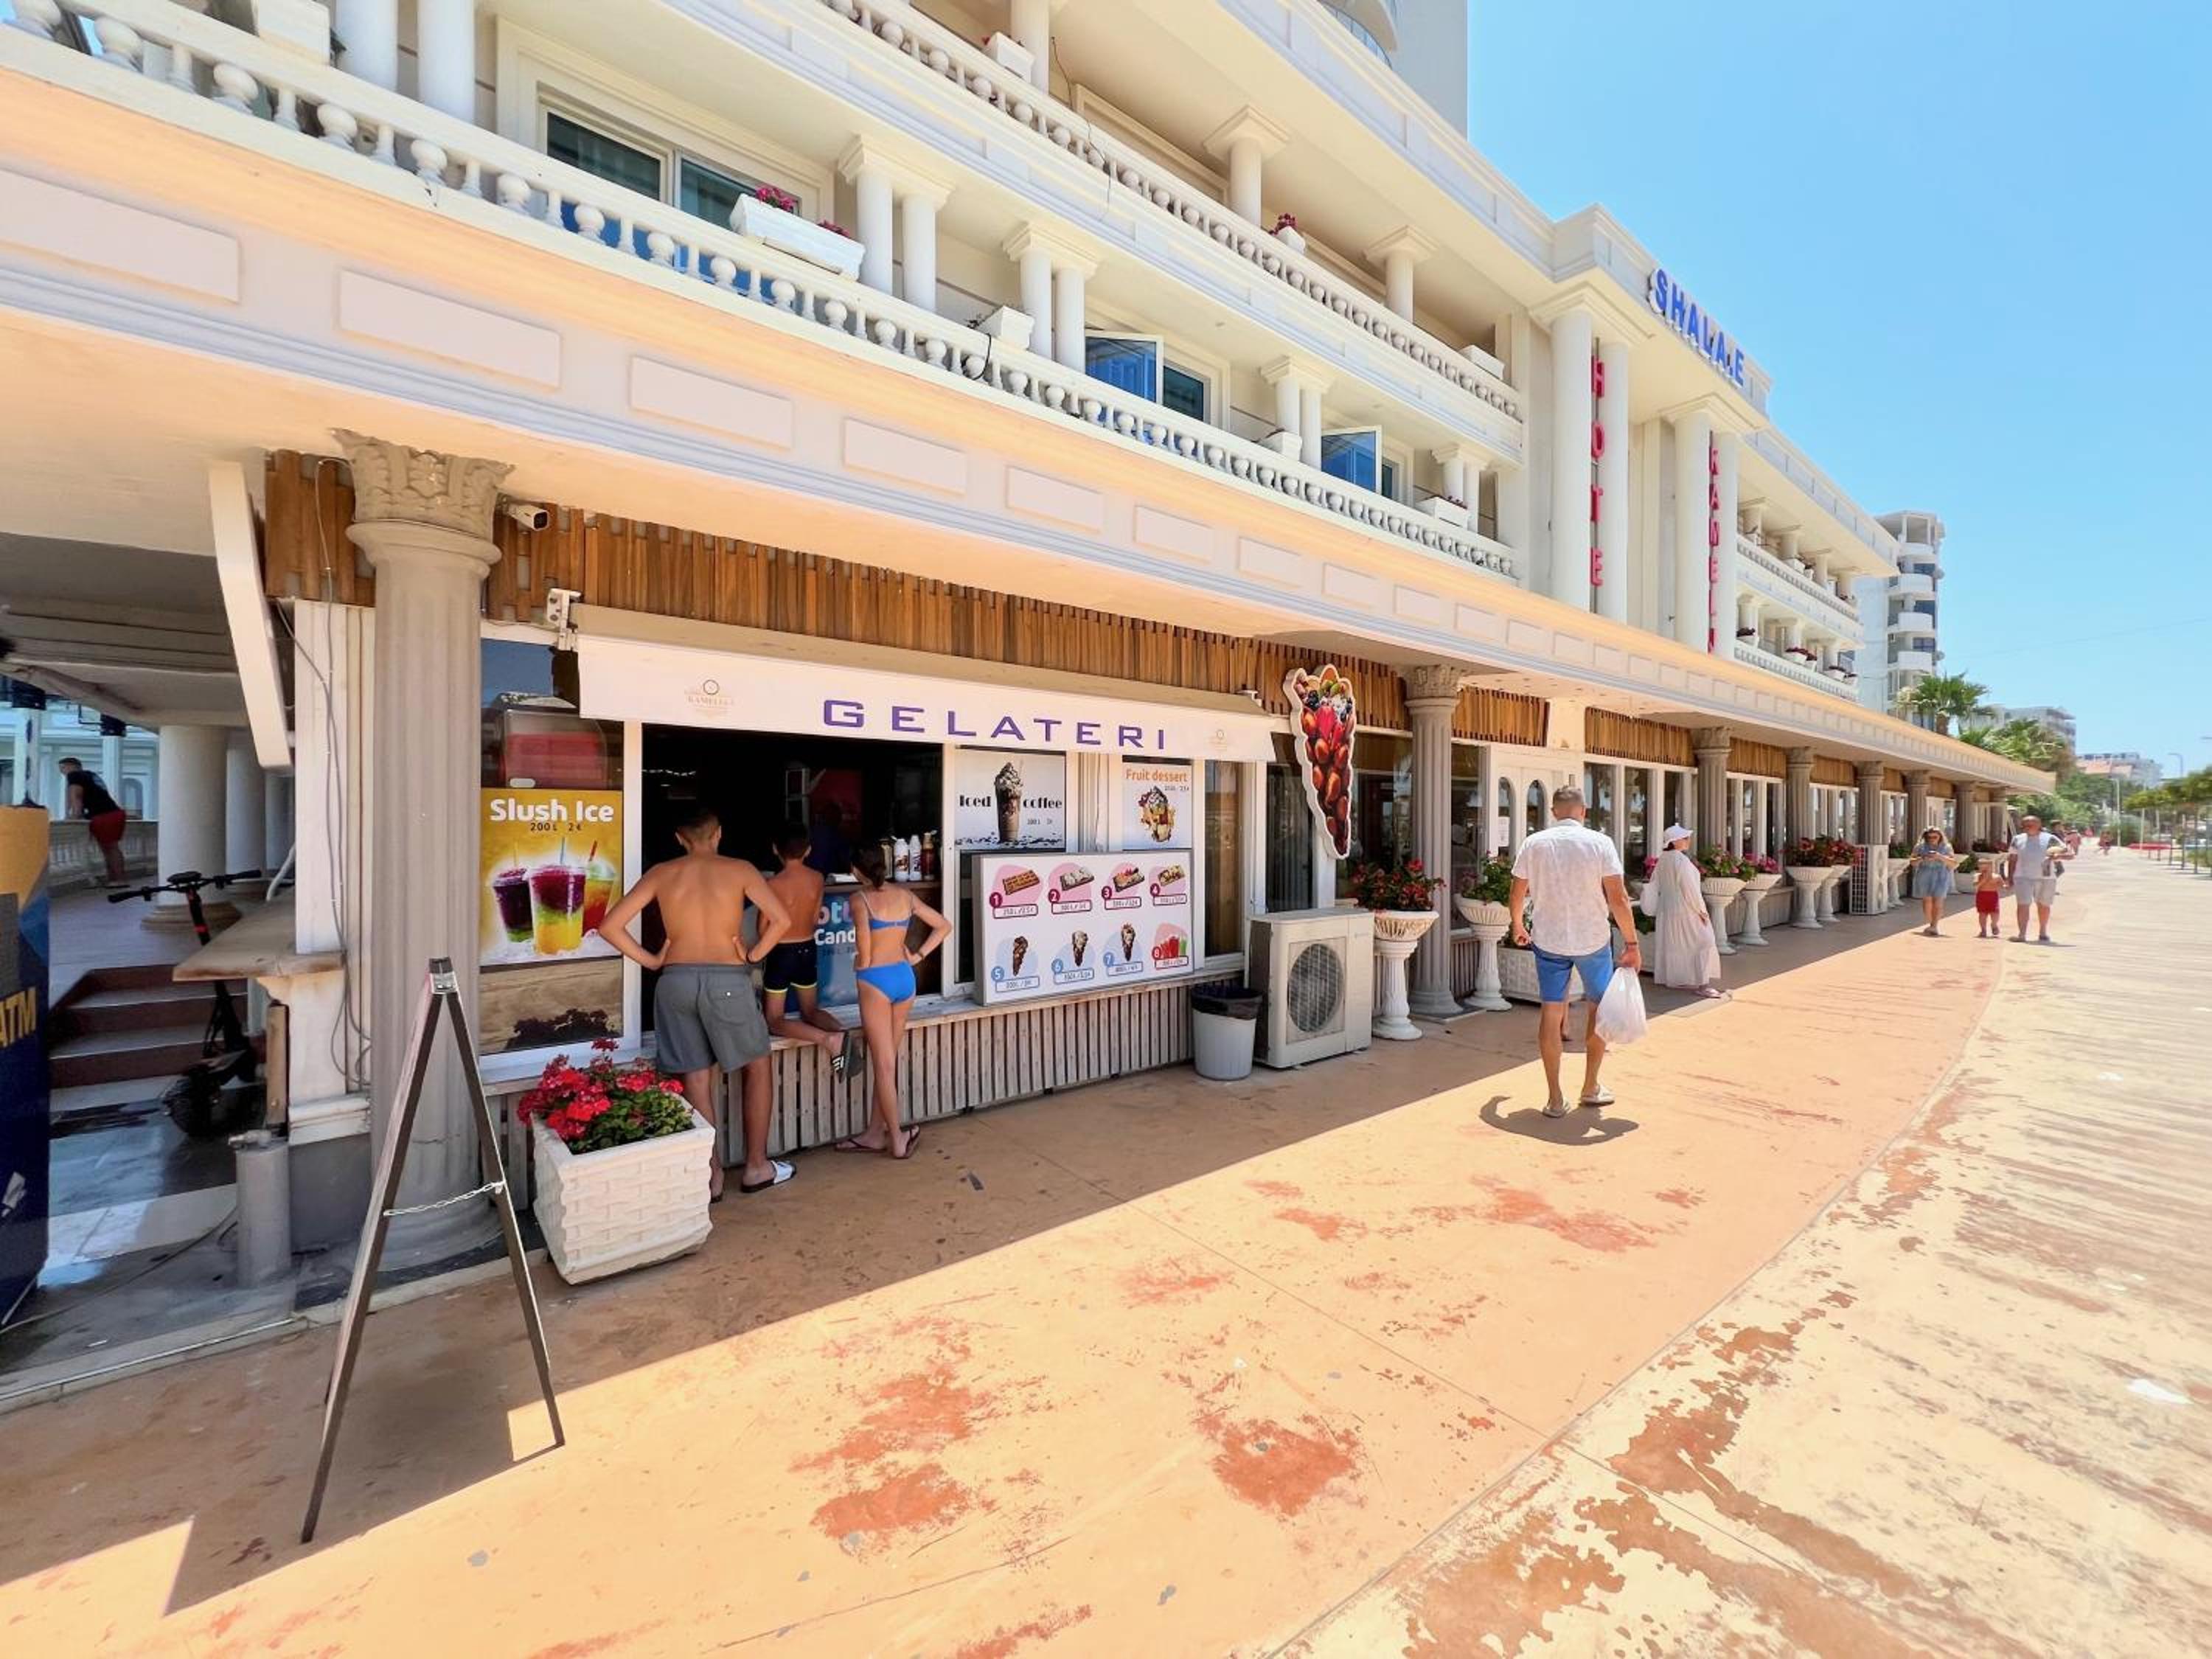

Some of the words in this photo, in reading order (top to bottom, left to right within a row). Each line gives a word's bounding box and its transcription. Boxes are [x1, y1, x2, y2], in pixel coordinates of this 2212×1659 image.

[823, 699, 1164, 750] GELATERI
[1126, 768, 1150, 781] Fruit
[1152, 769, 1188, 782] dessert
[959, 795, 992, 807] Iced
[1023, 797, 1062, 809] coffee
[490, 797, 568, 821] Slush
[576, 800, 614, 823] Ice
[992, 894, 999, 906] 1
[1051, 892, 1057, 902] 2
[994, 969, 1001, 978] 5
